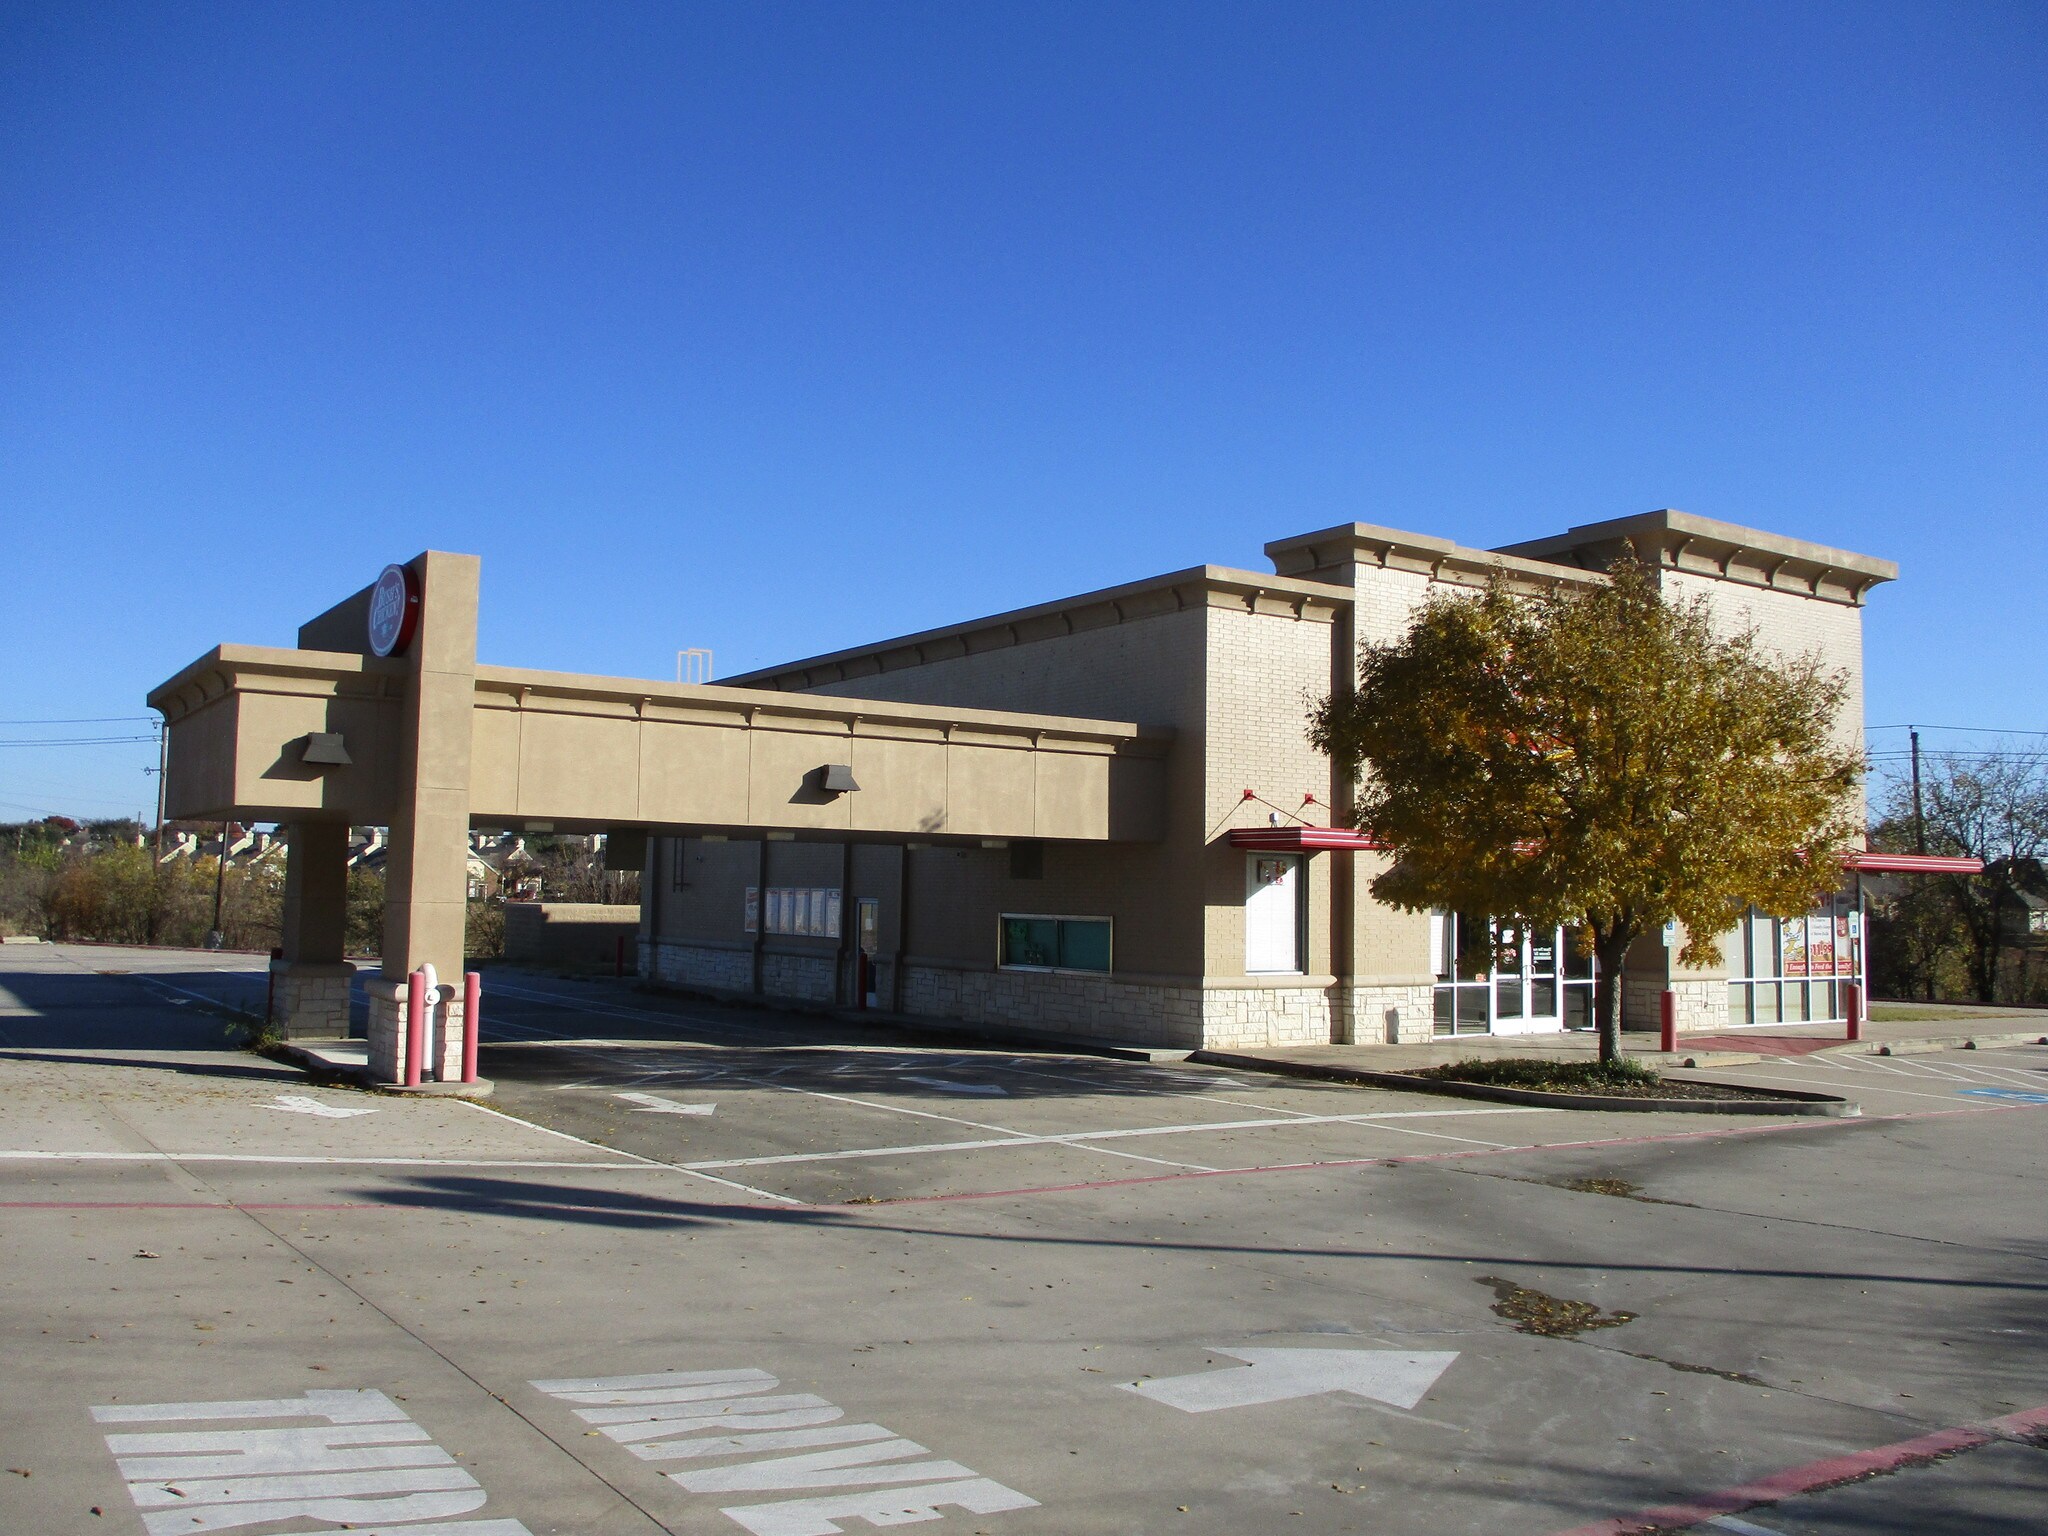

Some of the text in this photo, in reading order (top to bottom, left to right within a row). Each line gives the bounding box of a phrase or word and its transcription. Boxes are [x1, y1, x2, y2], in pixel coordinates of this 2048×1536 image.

[1838, 962, 1852, 972] amily!
[89, 1388, 537, 1536] THR
[527, 1368, 1042, 1536] DRIVE
